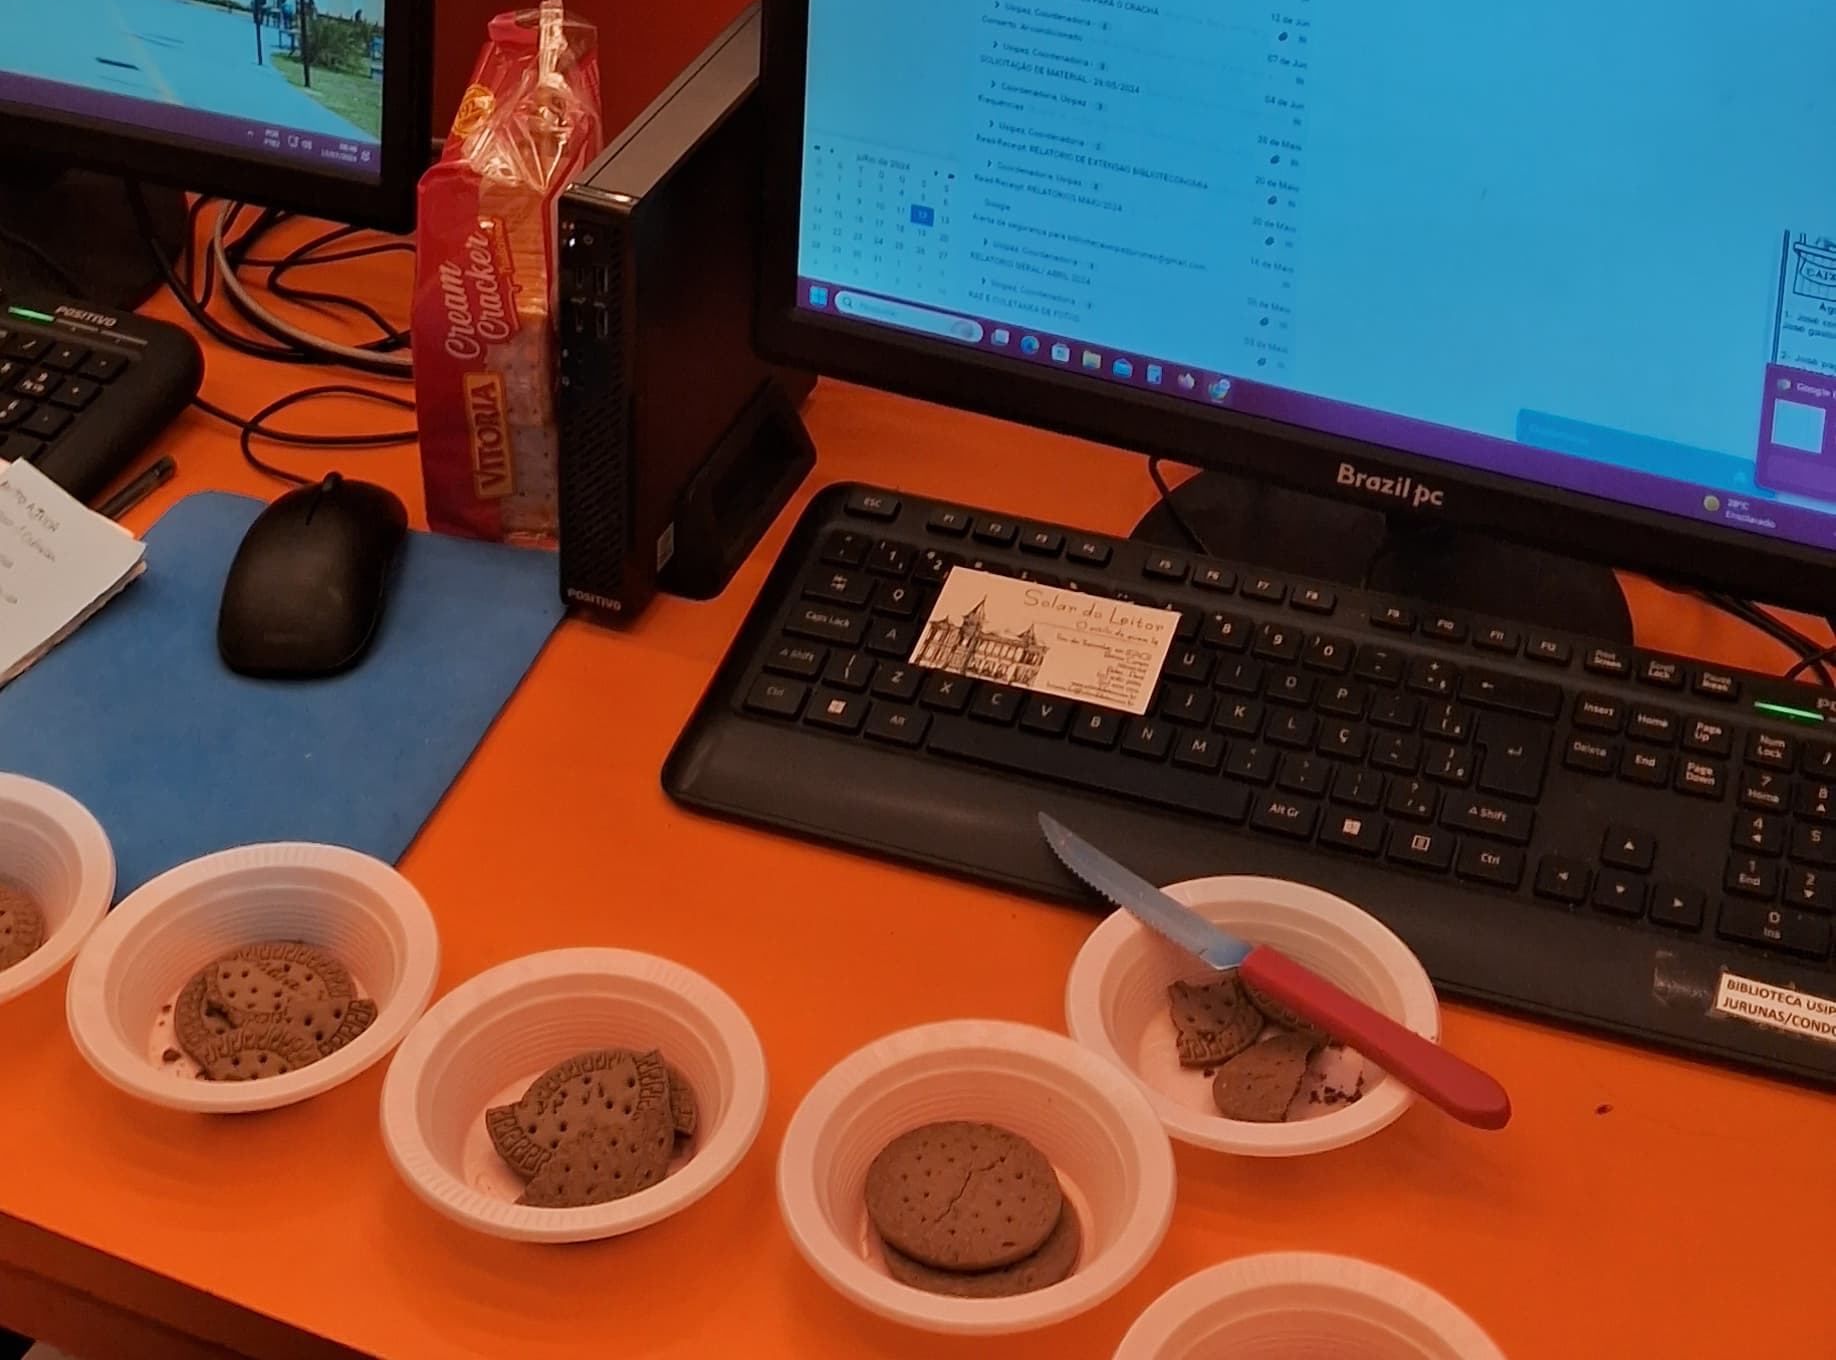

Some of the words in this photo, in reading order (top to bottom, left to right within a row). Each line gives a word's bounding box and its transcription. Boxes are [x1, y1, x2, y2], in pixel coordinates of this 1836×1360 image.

[464, 231, 510, 339] Cracker
[55, 305, 117, 327] POSITIVO
[438, 258, 480, 359] Cream
[1337, 462, 1411, 498] Brazil
[1412, 484, 1444, 508] pc
[567, 588, 621, 611] POSITIVO
[1024, 588, 1077, 614] Solar
[1082, 602, 1102, 618] do
[1109, 607, 1164, 631] Leitor
[1583, 702, 1614, 716] Insert
[1637, 714, 1669, 729] Home
[1695, 730, 1710, 743] Up
[1573, 741, 1608, 757] Delete
[1758, 747, 1783, 759] Lock
[1635, 755, 1656, 768] End
[1480, 807, 1508, 823] Shift
[1480, 852, 1500, 865] Ctrl
[1727, 979, 1802, 1007] BIBLIOTECA
